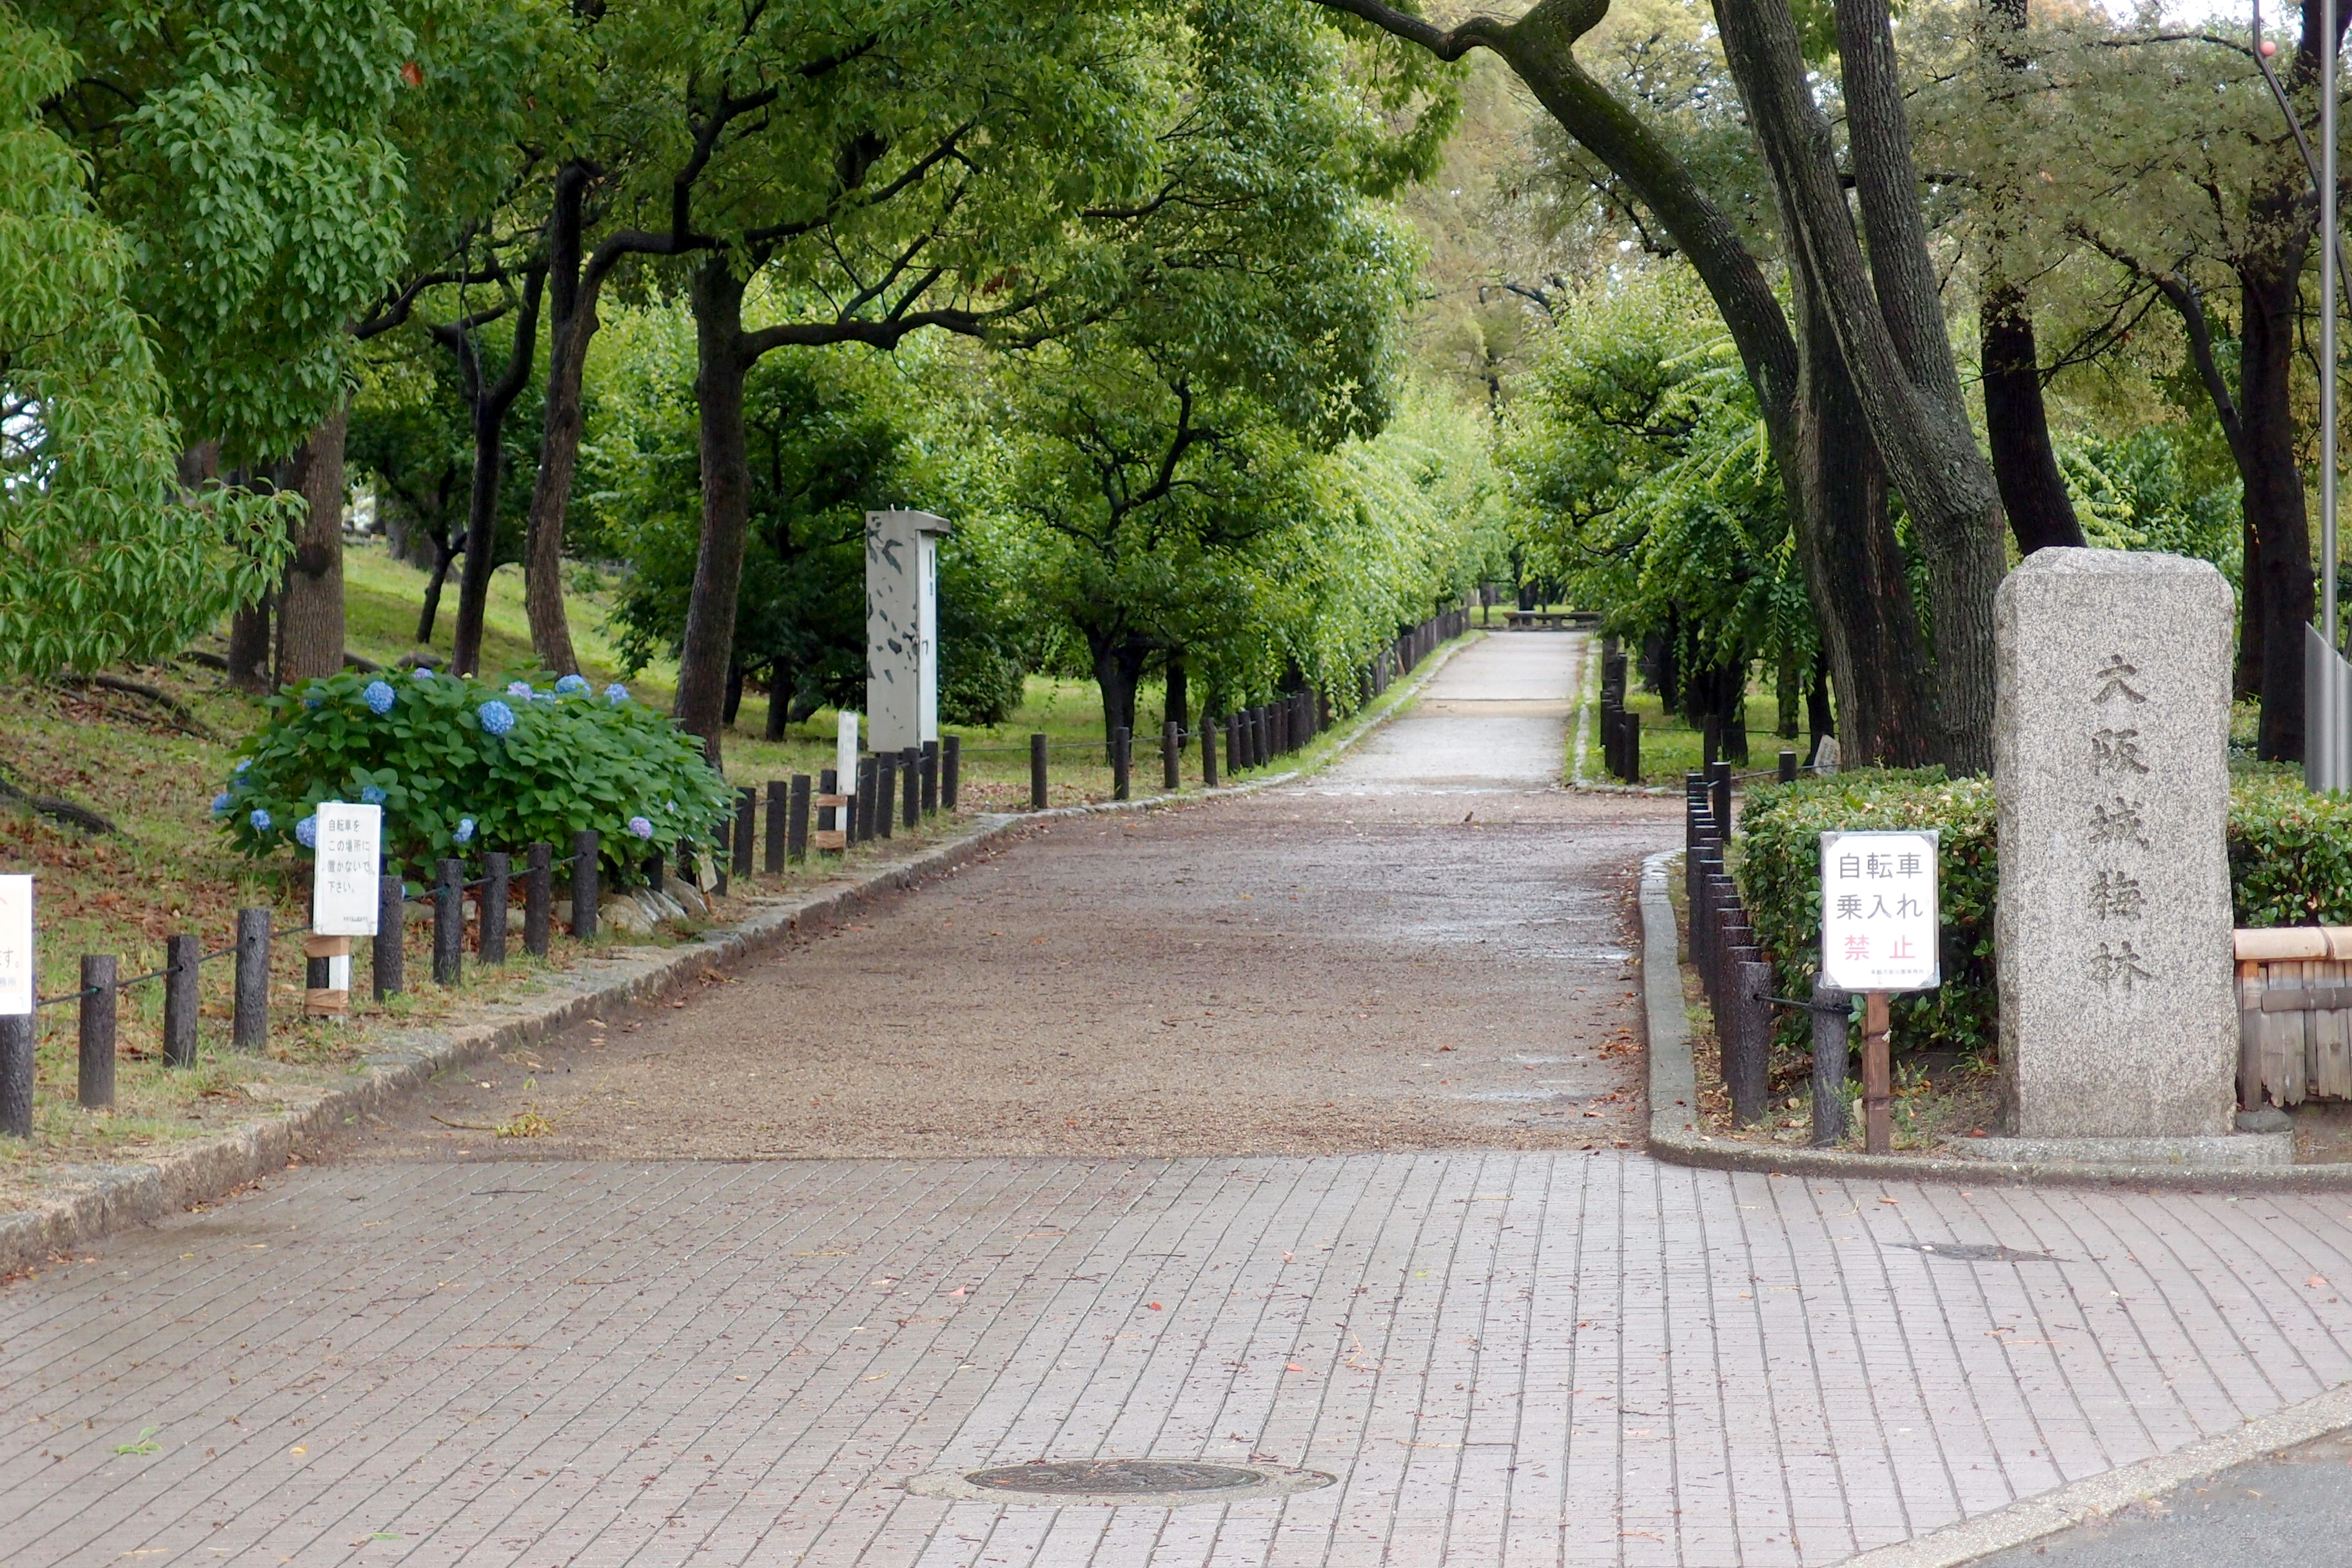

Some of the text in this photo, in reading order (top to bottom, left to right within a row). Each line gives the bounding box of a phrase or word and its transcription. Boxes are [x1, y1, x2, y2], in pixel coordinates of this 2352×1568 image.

[329, 819, 360, 832] 自転車を
[2086, 653, 2154, 993] 大阪城梅林
[328, 839, 369, 852] この場所に
[328, 860, 370, 873] 置かないで
[1839, 852, 1923, 879] 自転車
[328, 880, 355, 894] 下さい。
[1836, 893, 1923, 920] 乗入れ
